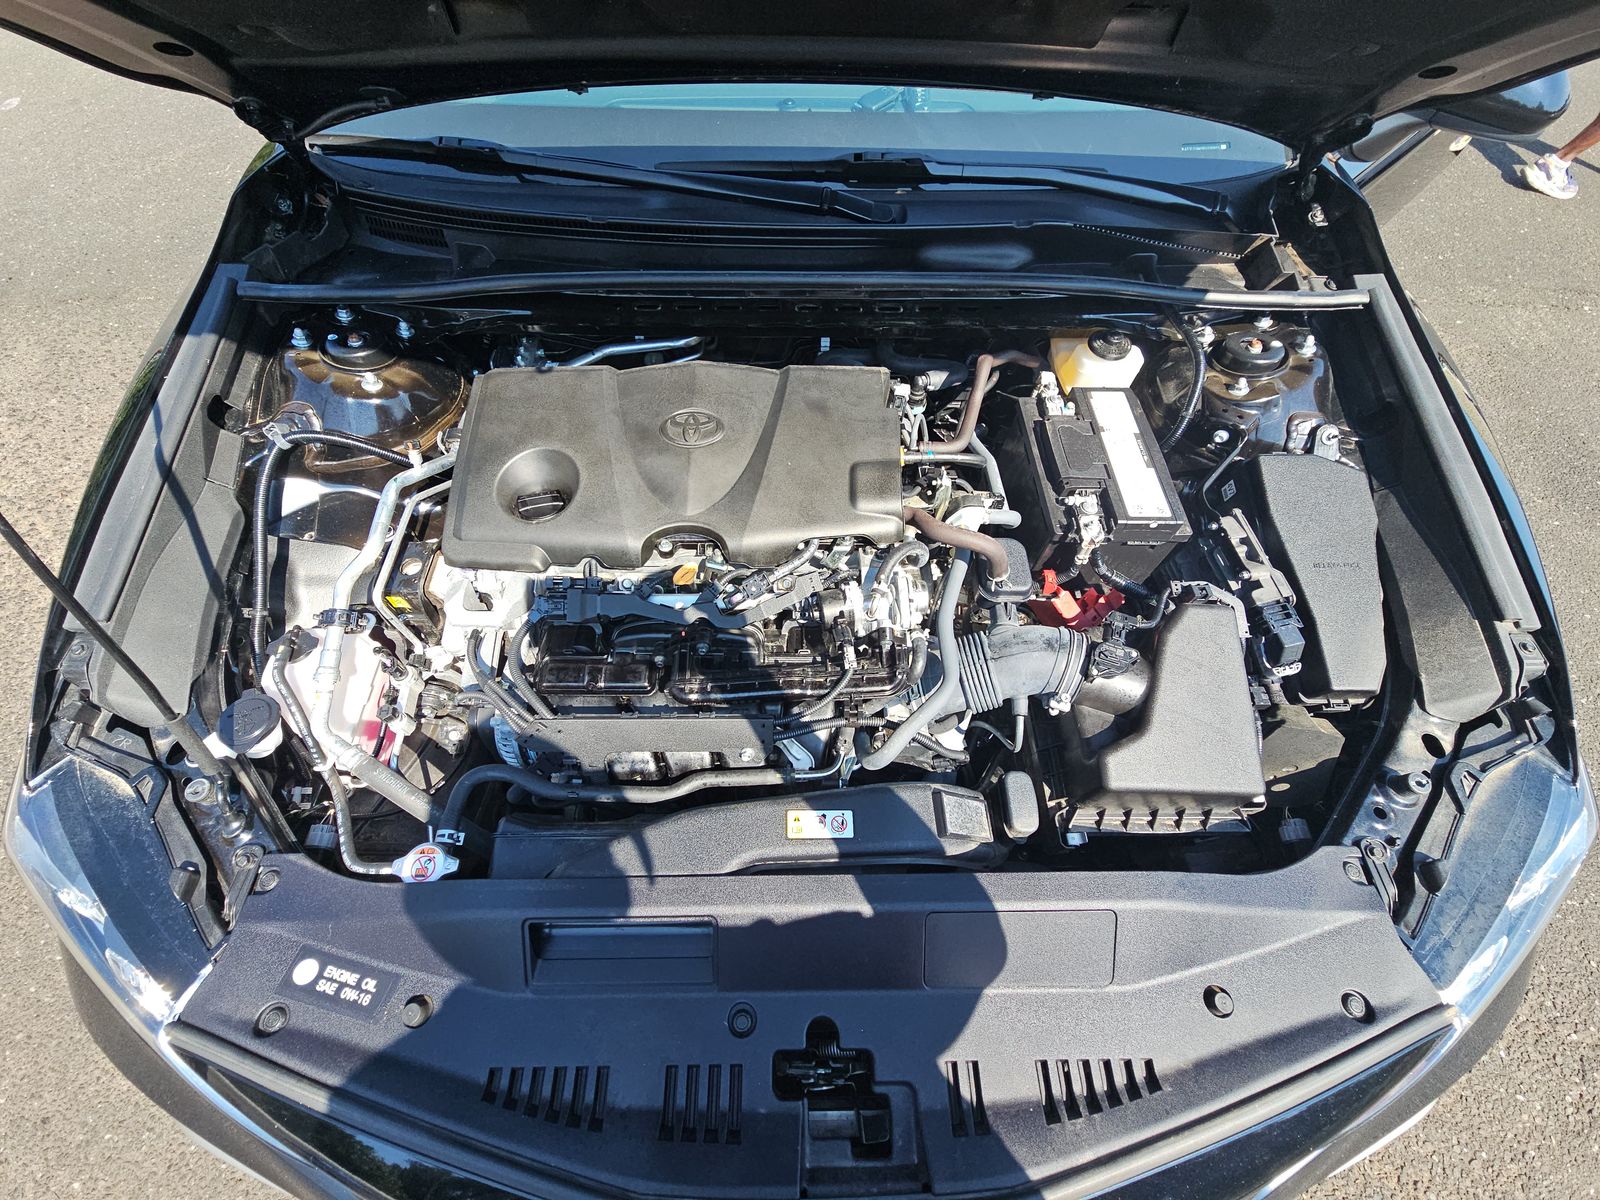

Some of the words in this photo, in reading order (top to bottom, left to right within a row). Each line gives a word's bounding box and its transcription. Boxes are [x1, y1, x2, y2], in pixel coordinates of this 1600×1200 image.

[315, 979, 340, 996] SAE
[340, 987, 372, 1007] 0W-16
[323, 965, 361, 987] ENGINE
[361, 977, 378, 993] OIL
